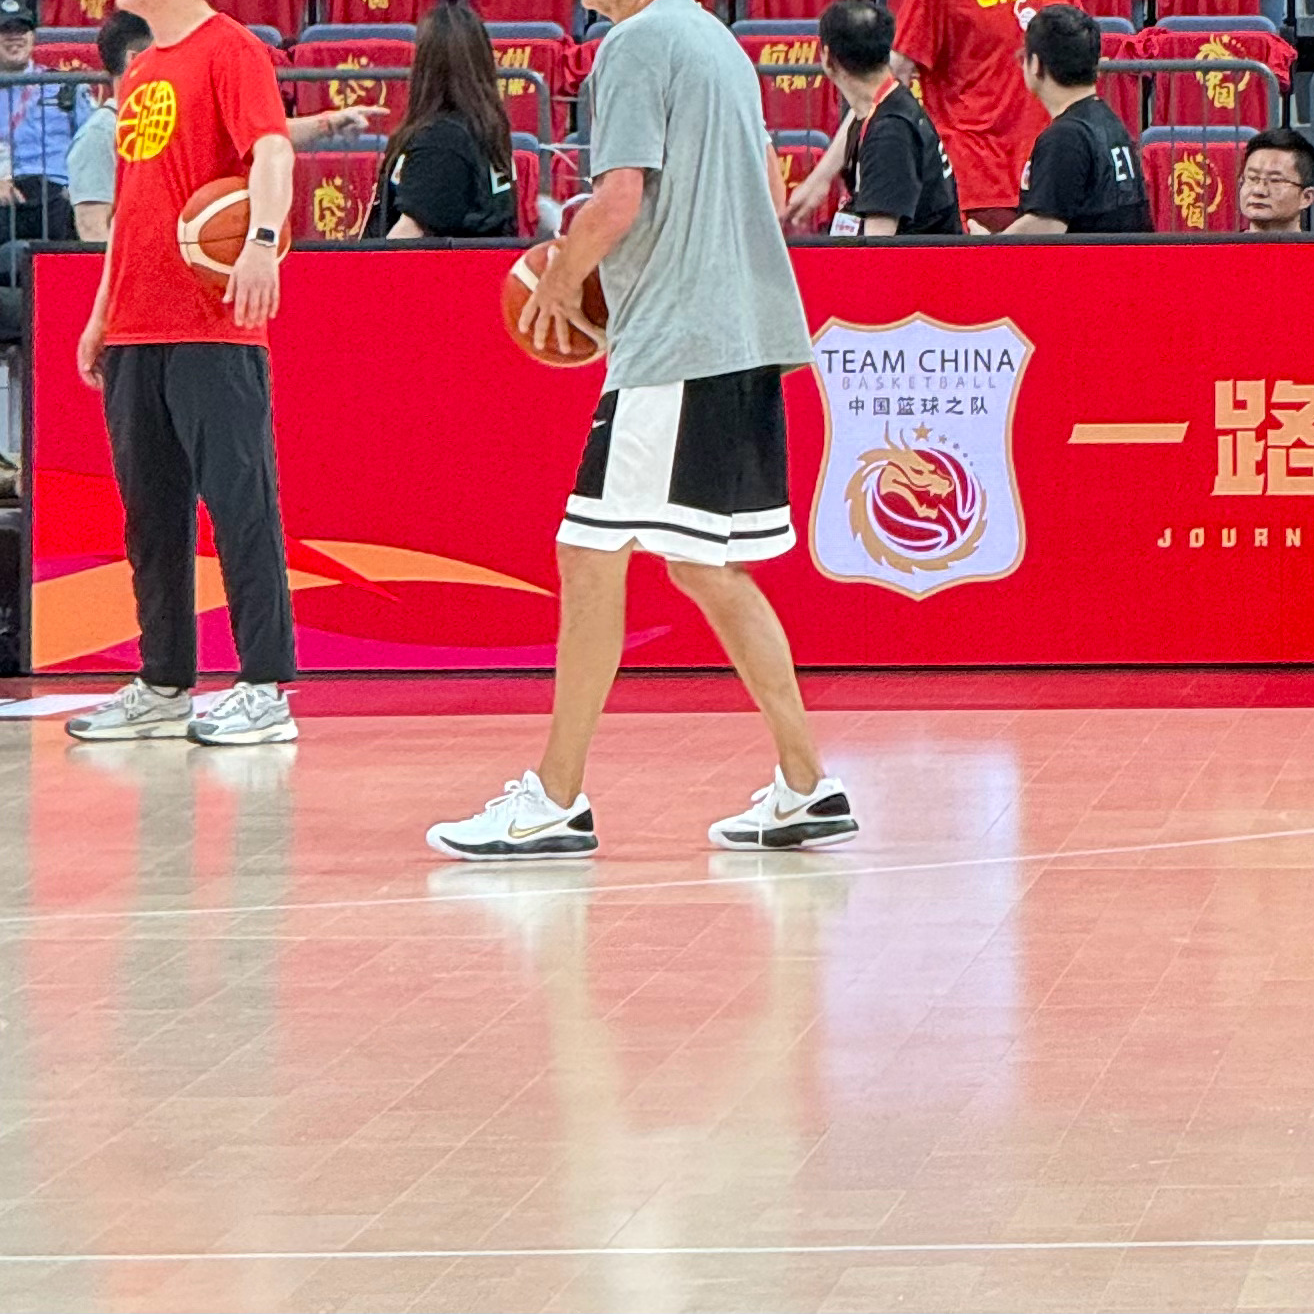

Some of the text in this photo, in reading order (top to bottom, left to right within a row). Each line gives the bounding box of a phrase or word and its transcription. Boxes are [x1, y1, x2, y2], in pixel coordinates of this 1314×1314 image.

[821, 348, 1015, 373] TEAM CHINA
[842, 375, 996, 390] BASKETBALL
[849, 396, 988, 416] 中国篮球之队
